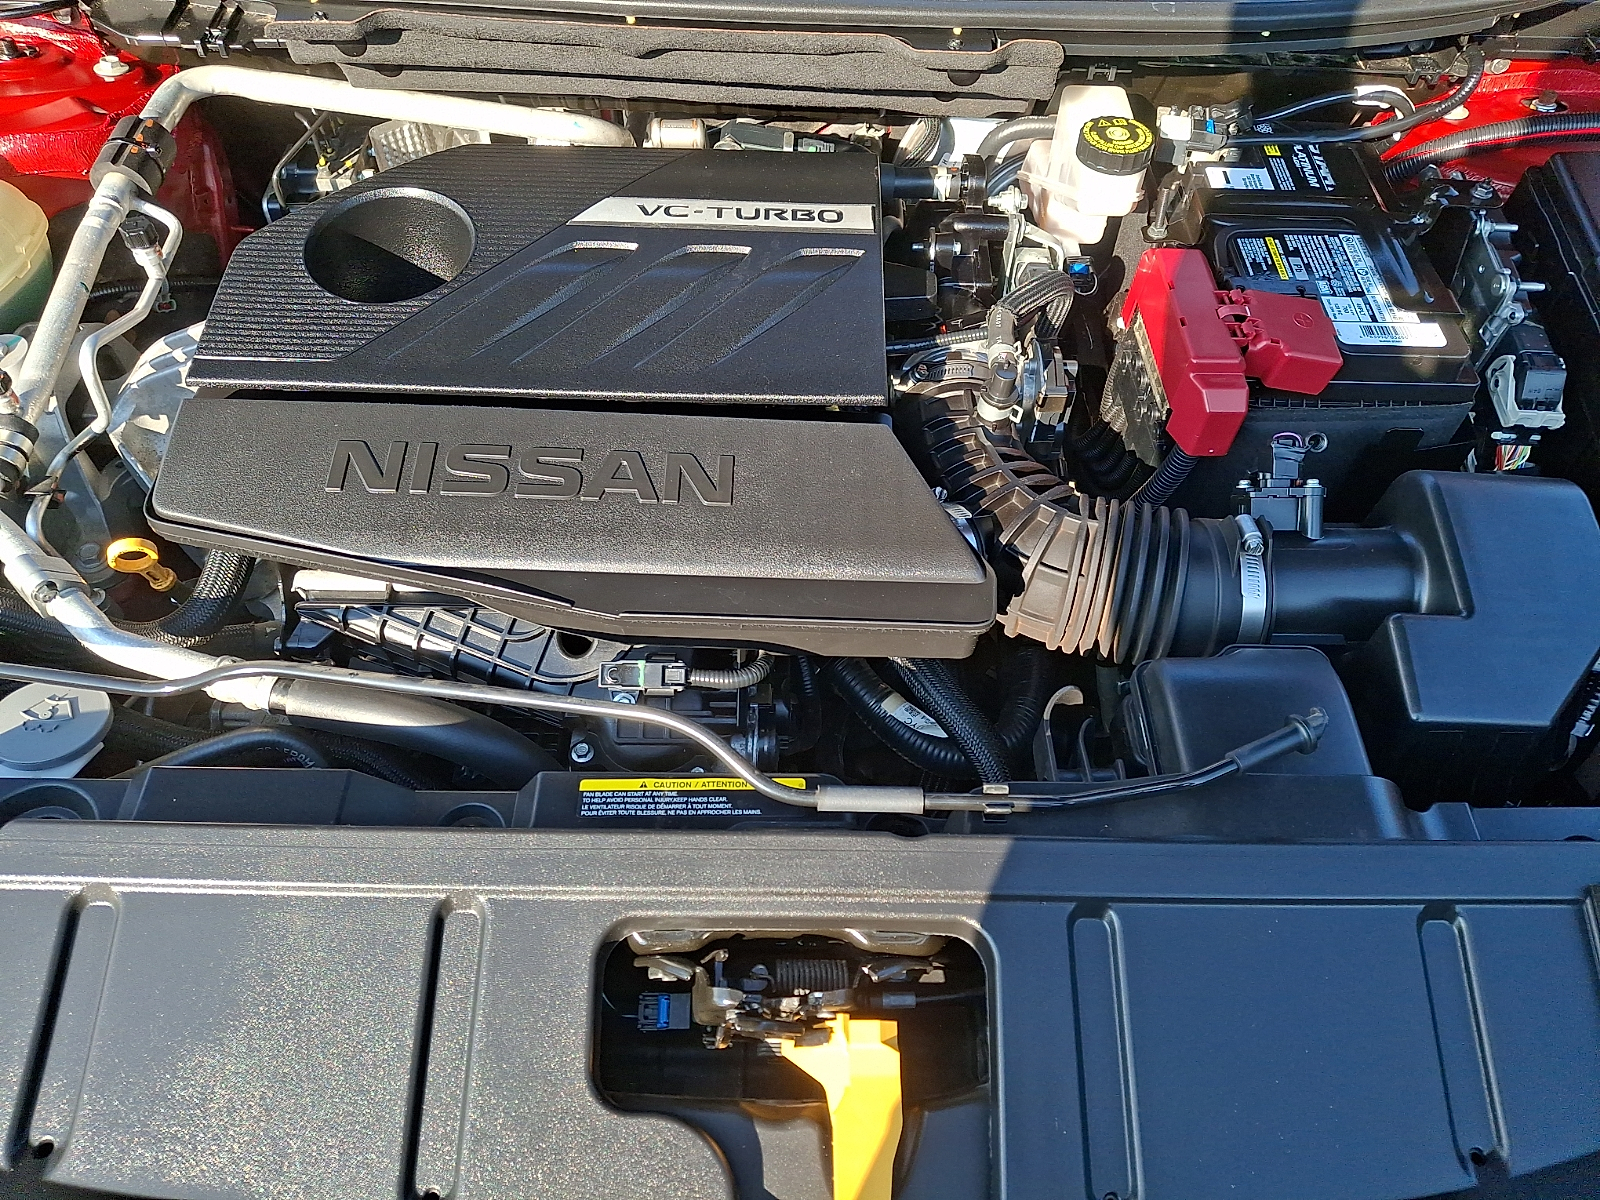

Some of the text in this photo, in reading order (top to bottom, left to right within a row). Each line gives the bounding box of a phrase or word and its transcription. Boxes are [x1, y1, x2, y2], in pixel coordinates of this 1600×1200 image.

[636, 203, 844, 223] VC-TURBO
[324, 440, 735, 506] NISSAN
[653, 781, 692, 789] CAUTION
[701, 780, 748, 788] ATTENTION
